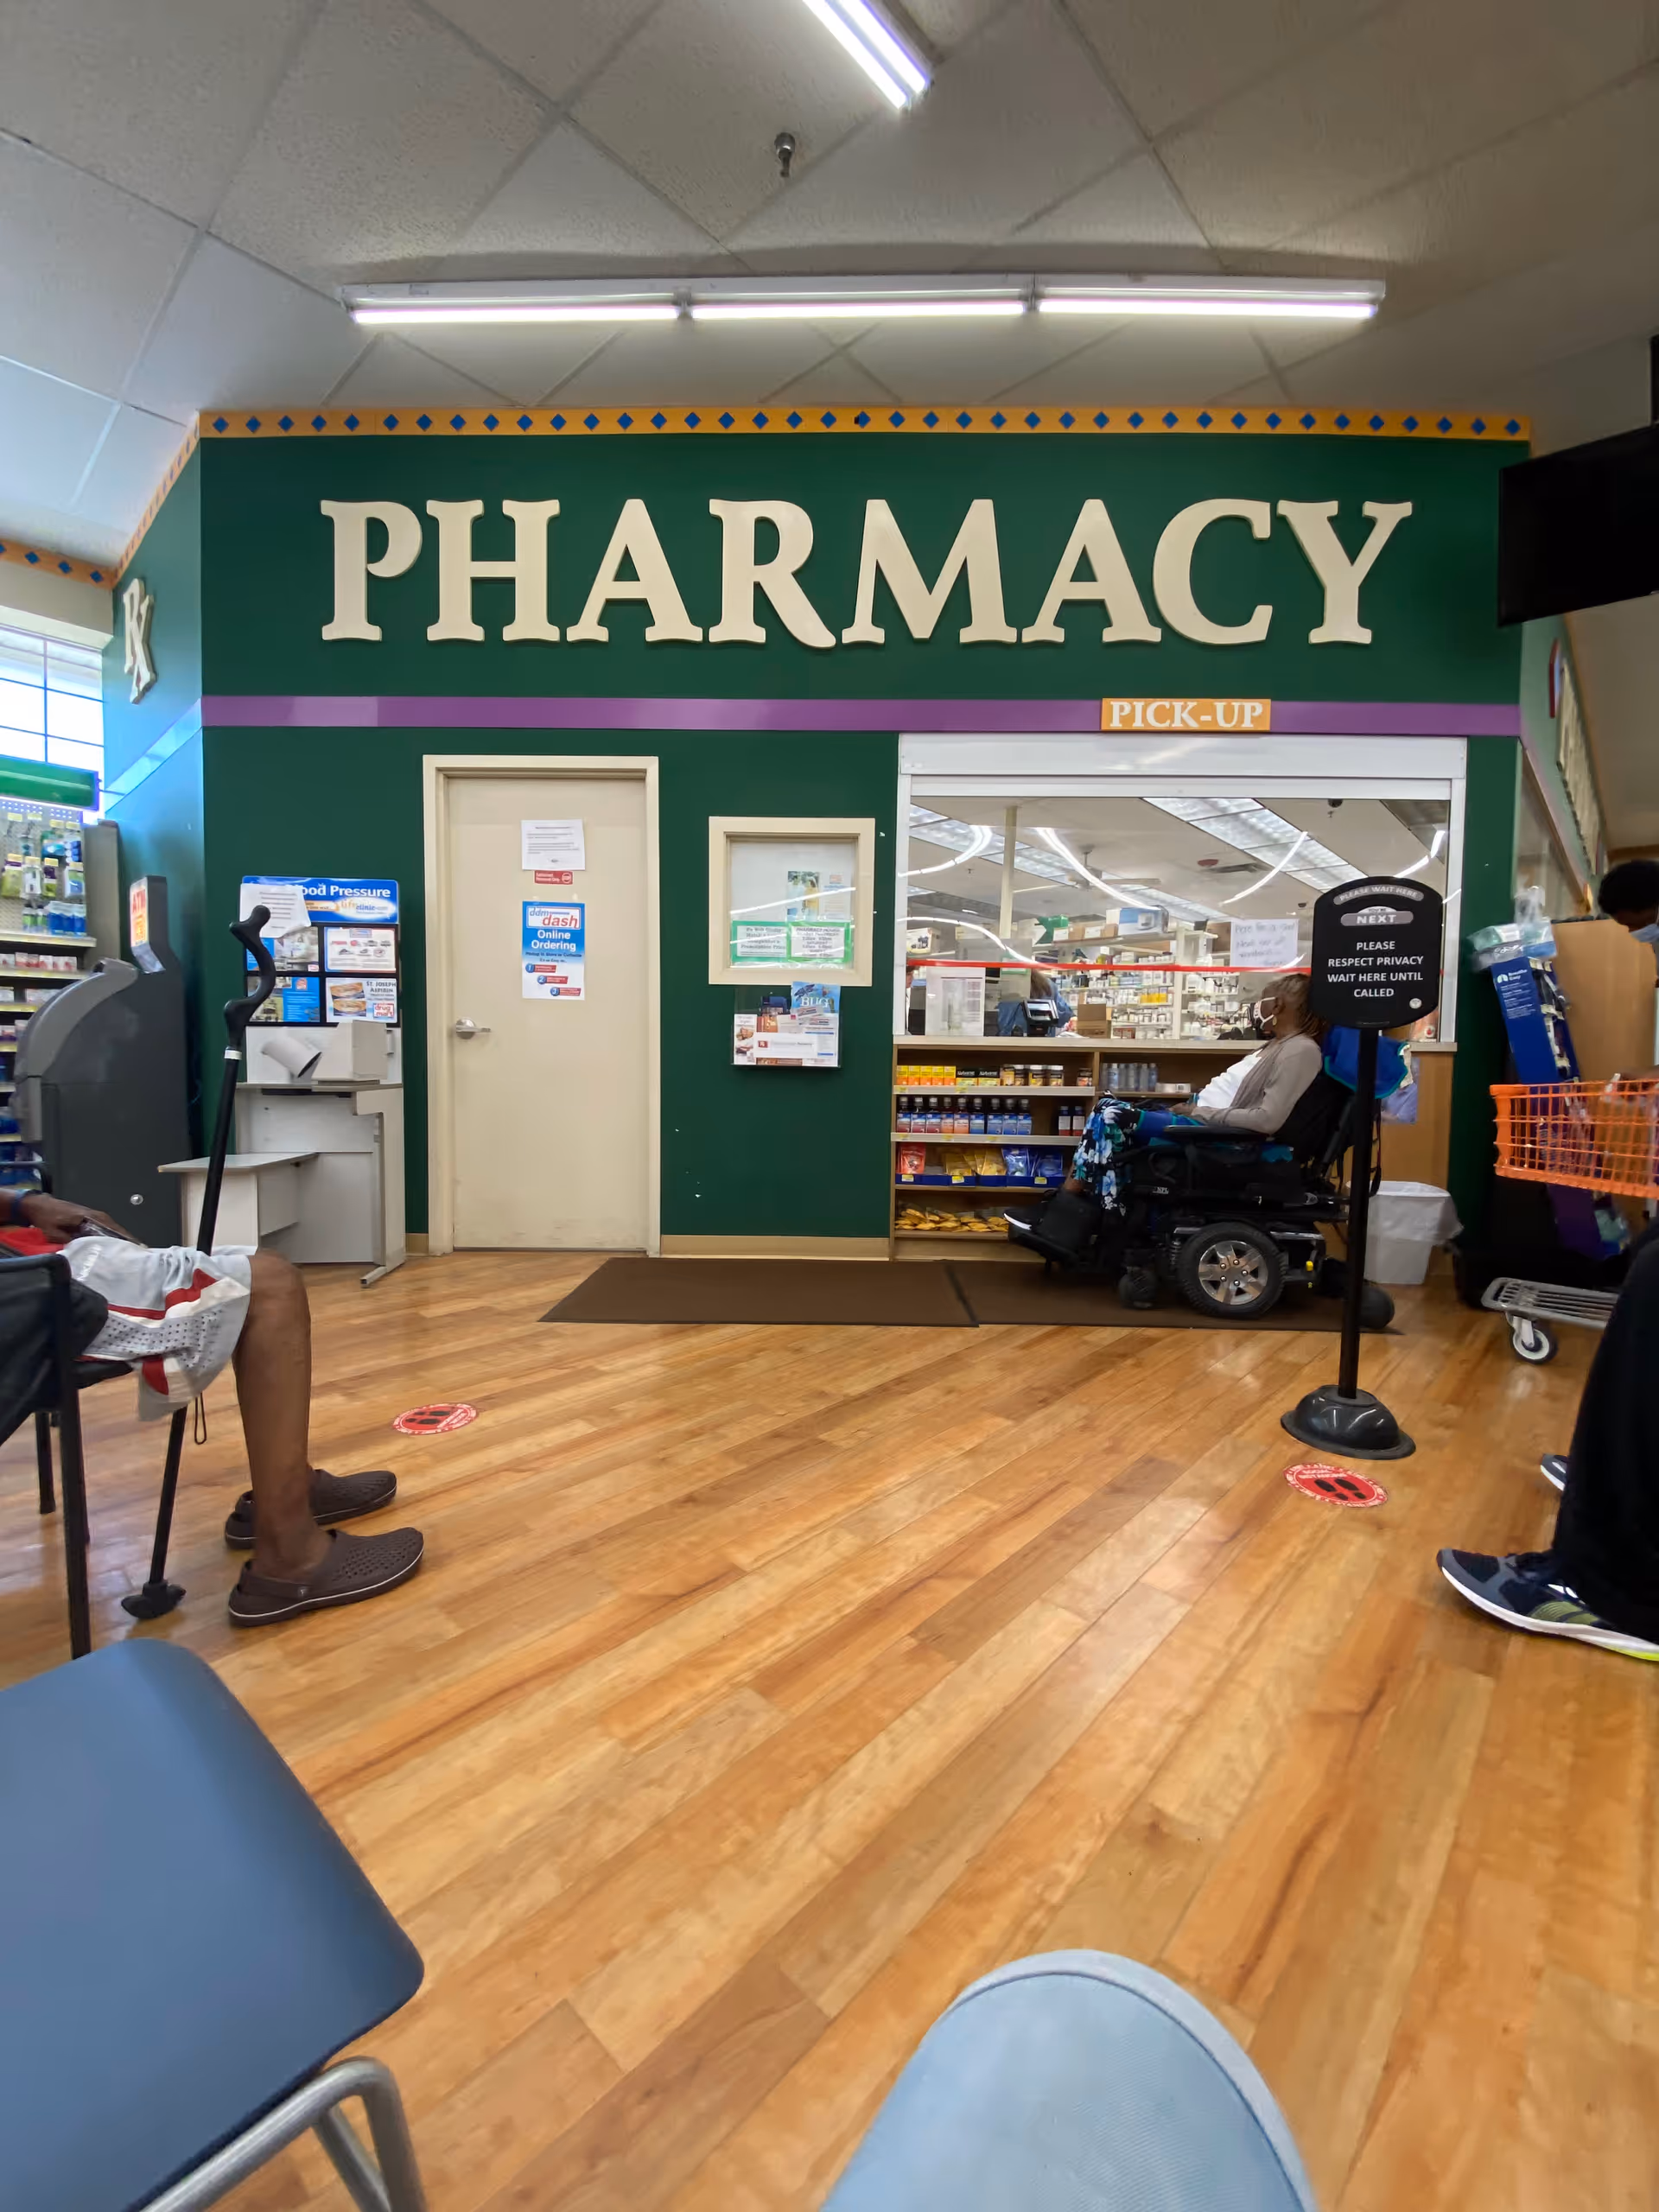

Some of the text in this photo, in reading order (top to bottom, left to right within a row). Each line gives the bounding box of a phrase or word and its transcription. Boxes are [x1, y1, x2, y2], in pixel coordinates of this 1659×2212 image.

[321, 498, 1413, 649] PHARMACY
[1109, 701, 1262, 728] PICK-UP
[330, 885, 391, 898] Pressure
[1339, 887, 1369, 900] PLEASE
[1395, 887, 1418, 898] HERE
[542, 915, 578, 928] dash
[1357, 914, 1396, 924] NEXT
[537, 930, 571, 939] Online
[531, 939, 576, 952] Ordering
[1356, 941, 1396, 950] PLEASE
[1328, 956, 1424, 967] RESPECT PRIVACY
[1327, 972, 1424, 982] WAIT HERE UNTIL
[1354, 988, 1395, 997] CALLED
